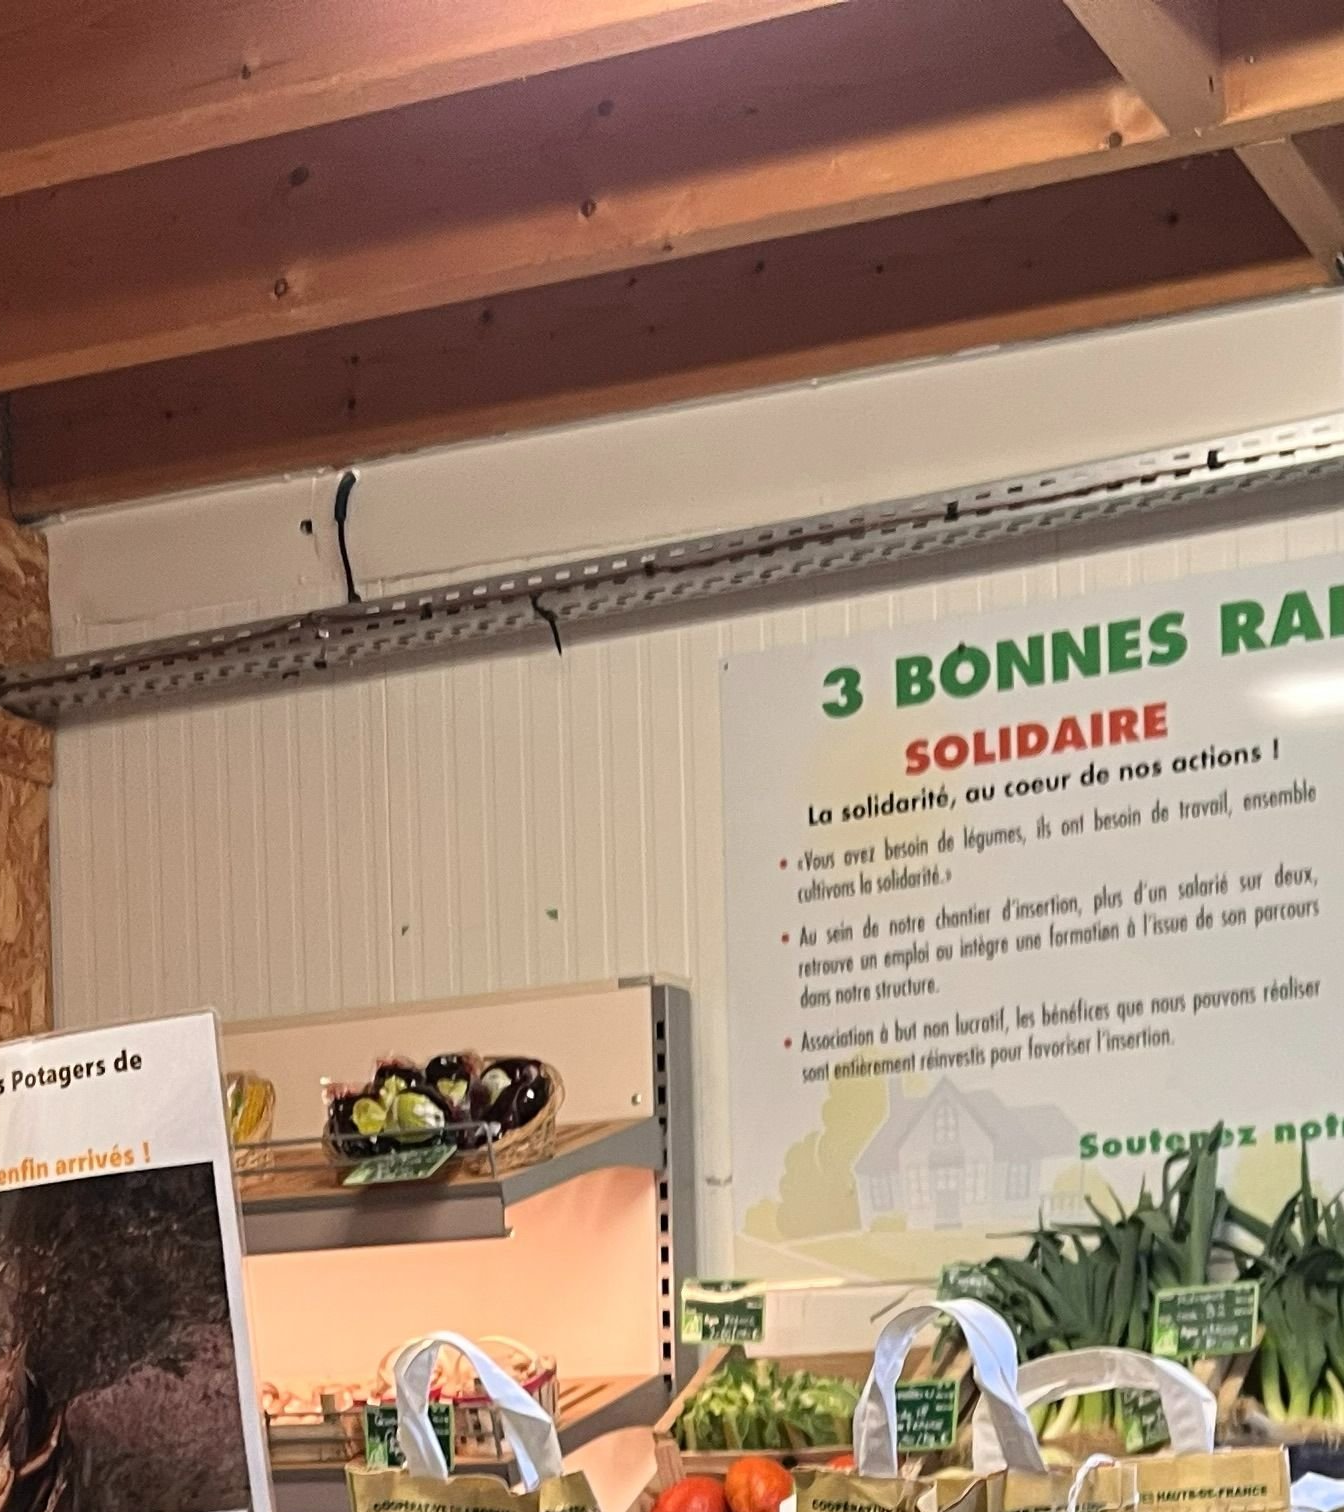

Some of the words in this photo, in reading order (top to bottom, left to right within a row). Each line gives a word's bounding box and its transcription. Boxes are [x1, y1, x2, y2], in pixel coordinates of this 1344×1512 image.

[825, 668, 861, 716] 3
[895, 612, 1186, 705] BONNES
[904, 701, 1169, 776] SOLIDAIRE
[808, 805, 833, 826] La
[842, 787, 956, 821] solidarité,
[965, 785, 995, 803] au
[1004, 775, 1070, 798] coeur
[1080, 762, 1109, 786] de
[1119, 761, 1162, 781] nos
[1172, 746, 1261, 773] actions
[843, 846, 876, 866] avez
[883, 837, 929, 860] besoin
[937, 829, 955, 853] de
[963, 826, 1027, 853] légumes,
[1036, 815, 1052, 839] ils
[1060, 814, 1084, 836] ont
[1093, 807, 1142, 831] besoin
[1150, 799, 1169, 824] de
[1179, 790, 1233, 819] travail,
[1242, 779, 1317, 810] ensemble
[797, 879, 856, 903] cultivons
[859, 871, 873, 895] la
[799, 925, 818, 947] Au
[825, 922, 854, 943] sein
[862, 914, 880, 939] de
[888, 915, 926, 936] notre
[934, 905, 991, 930] chantier
[1001, 897, 1083, 921] d'insertion,
[1093, 886, 1124, 915] plus
[1133, 881, 1168, 905] d'un
[1177, 874, 1229, 899] salarié
[1238, 873, 1263, 892] sur
[1274, 865, 1319, 887] deux,
[11, 1059, 106, 1091] Potagers
[113, 1050, 142, 1073] de
[54, 1143, 135, 1178] arrivés
